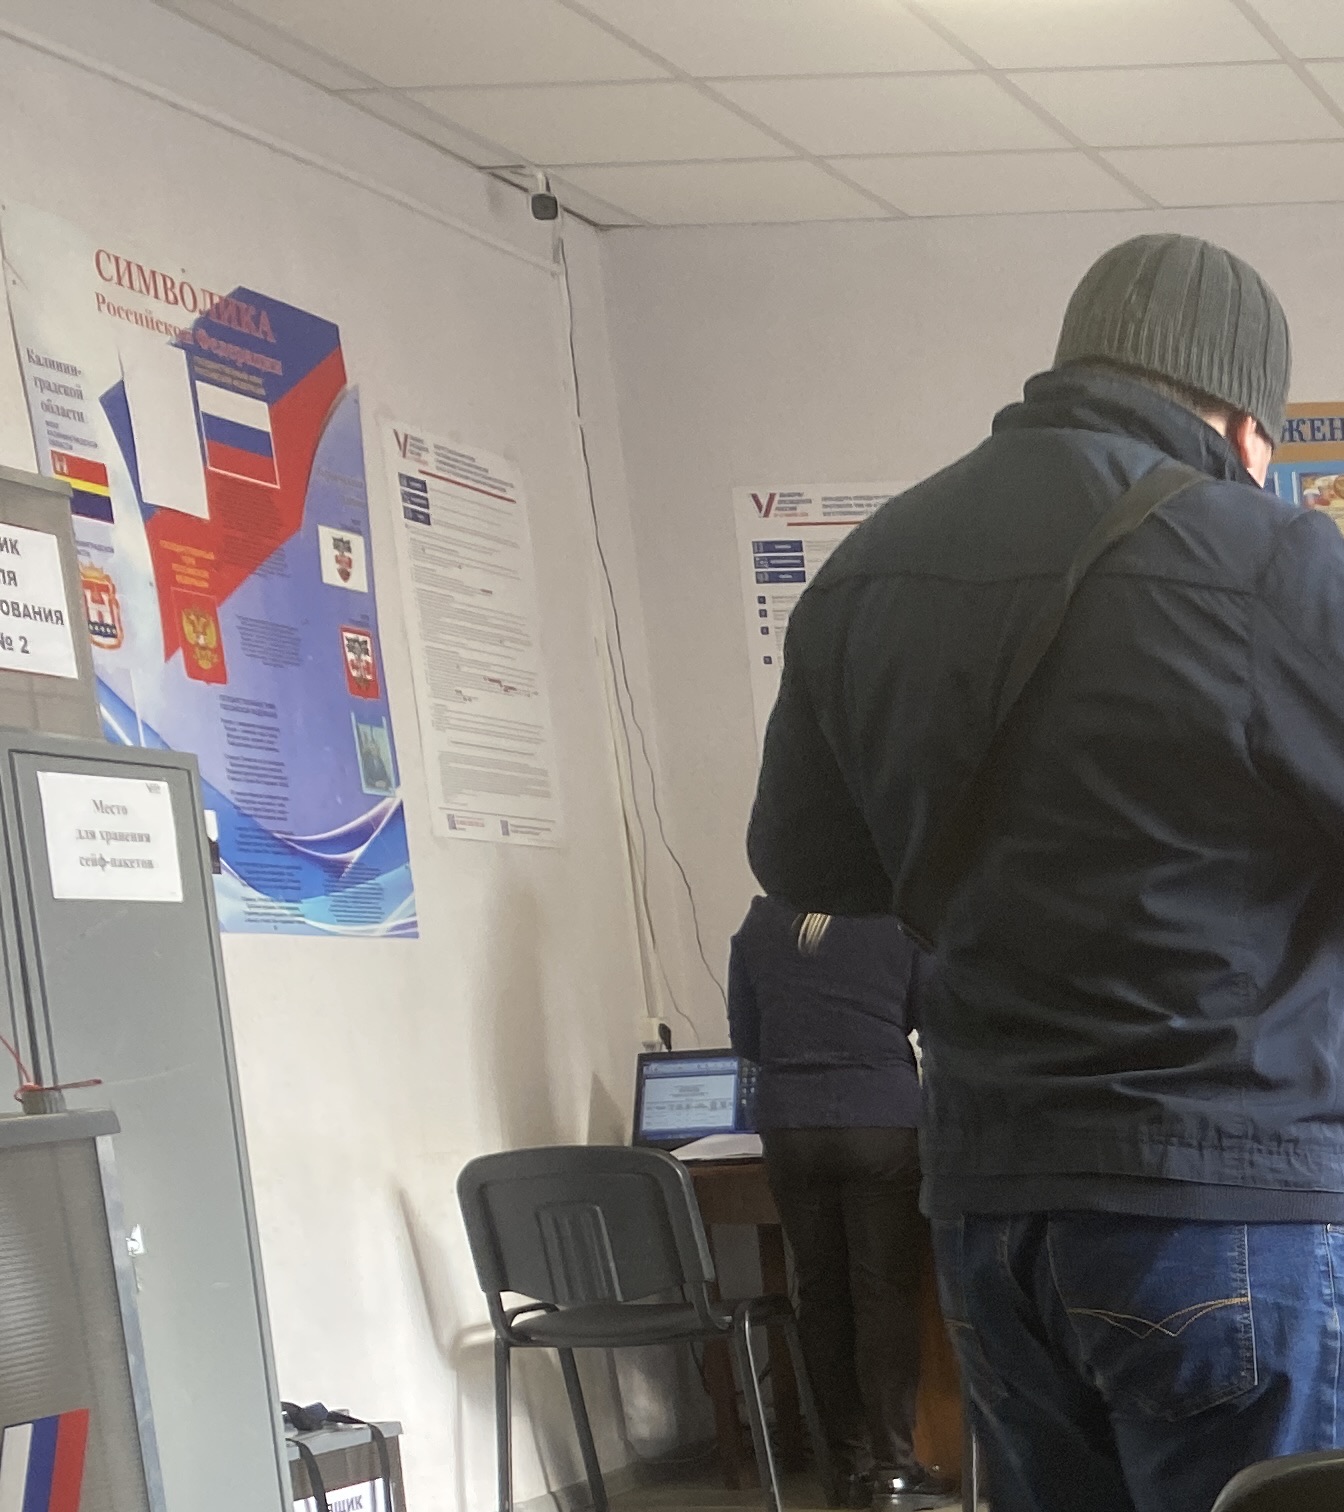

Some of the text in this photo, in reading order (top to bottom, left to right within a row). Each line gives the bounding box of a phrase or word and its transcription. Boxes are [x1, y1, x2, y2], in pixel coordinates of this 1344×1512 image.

[95, 248, 277, 343] СИМВОЛИКА
[0, 599, 64, 626] ОВАНИЯ
[19, 635, 30, 655] 2
[92, 798, 128, 815] Место
[76, 828, 151, 845] для хранения
